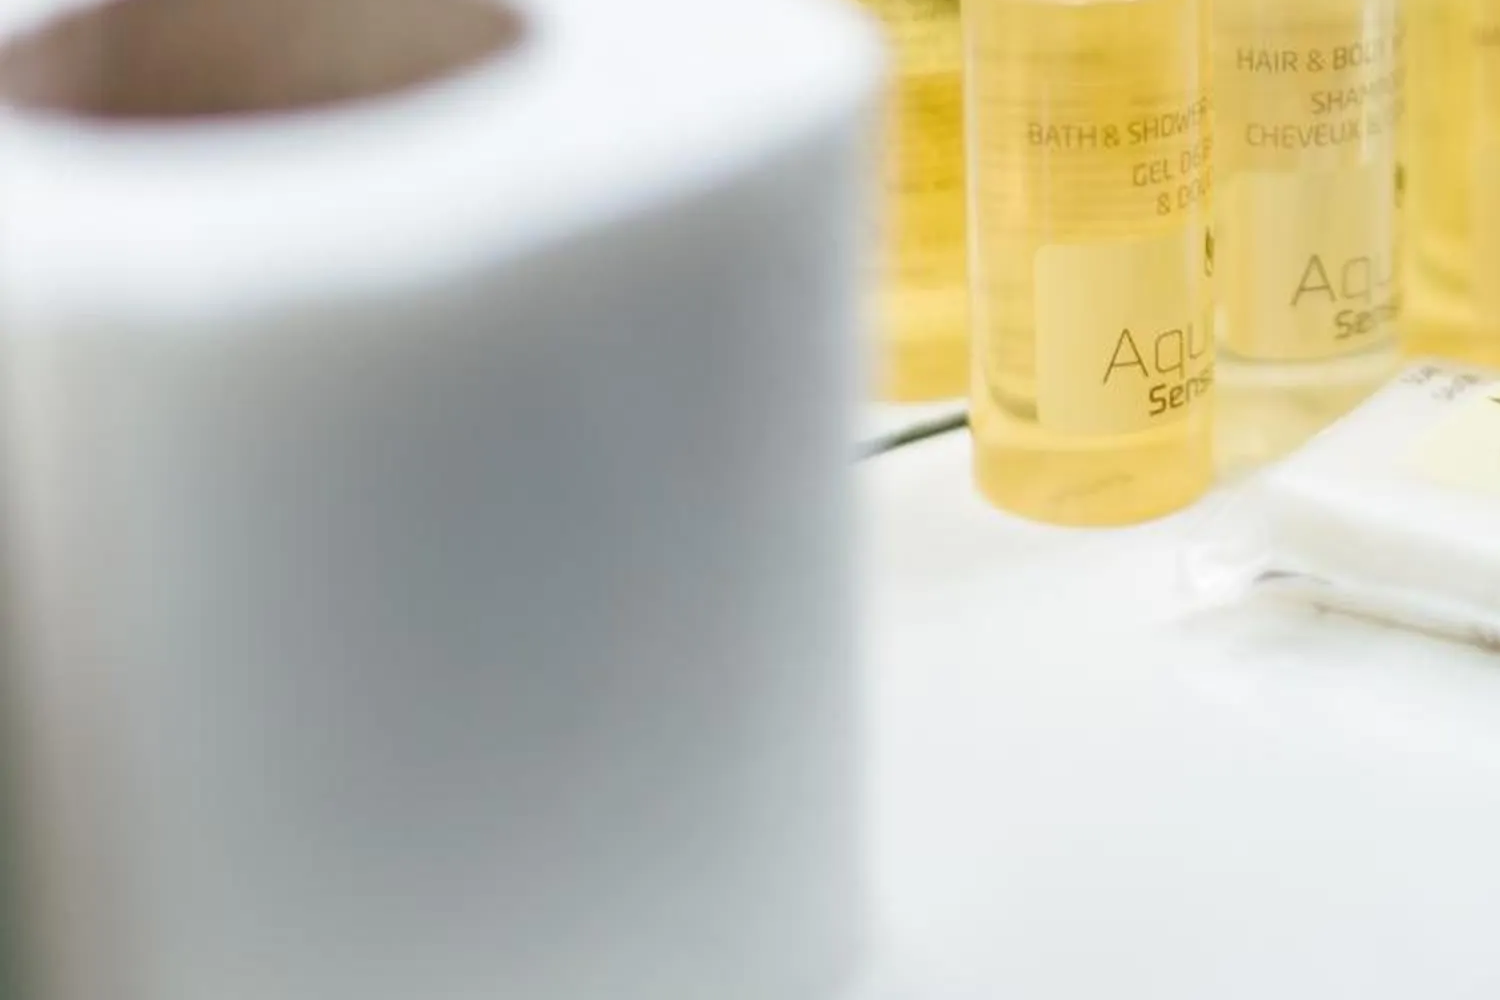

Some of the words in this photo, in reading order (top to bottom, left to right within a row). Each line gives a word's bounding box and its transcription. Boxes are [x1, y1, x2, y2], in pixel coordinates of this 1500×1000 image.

[1236, 46, 1299, 73] HAIR
[1306, 48, 1327, 73] &
[1026, 121, 1097, 152] BATH
[1102, 123, 1121, 149] &
[1245, 119, 1361, 150] CHEVEUX
[1132, 158, 1175, 187] GEL
[1102, 320, 1208, 386] Aqu
[1148, 364, 1213, 417] Sens
